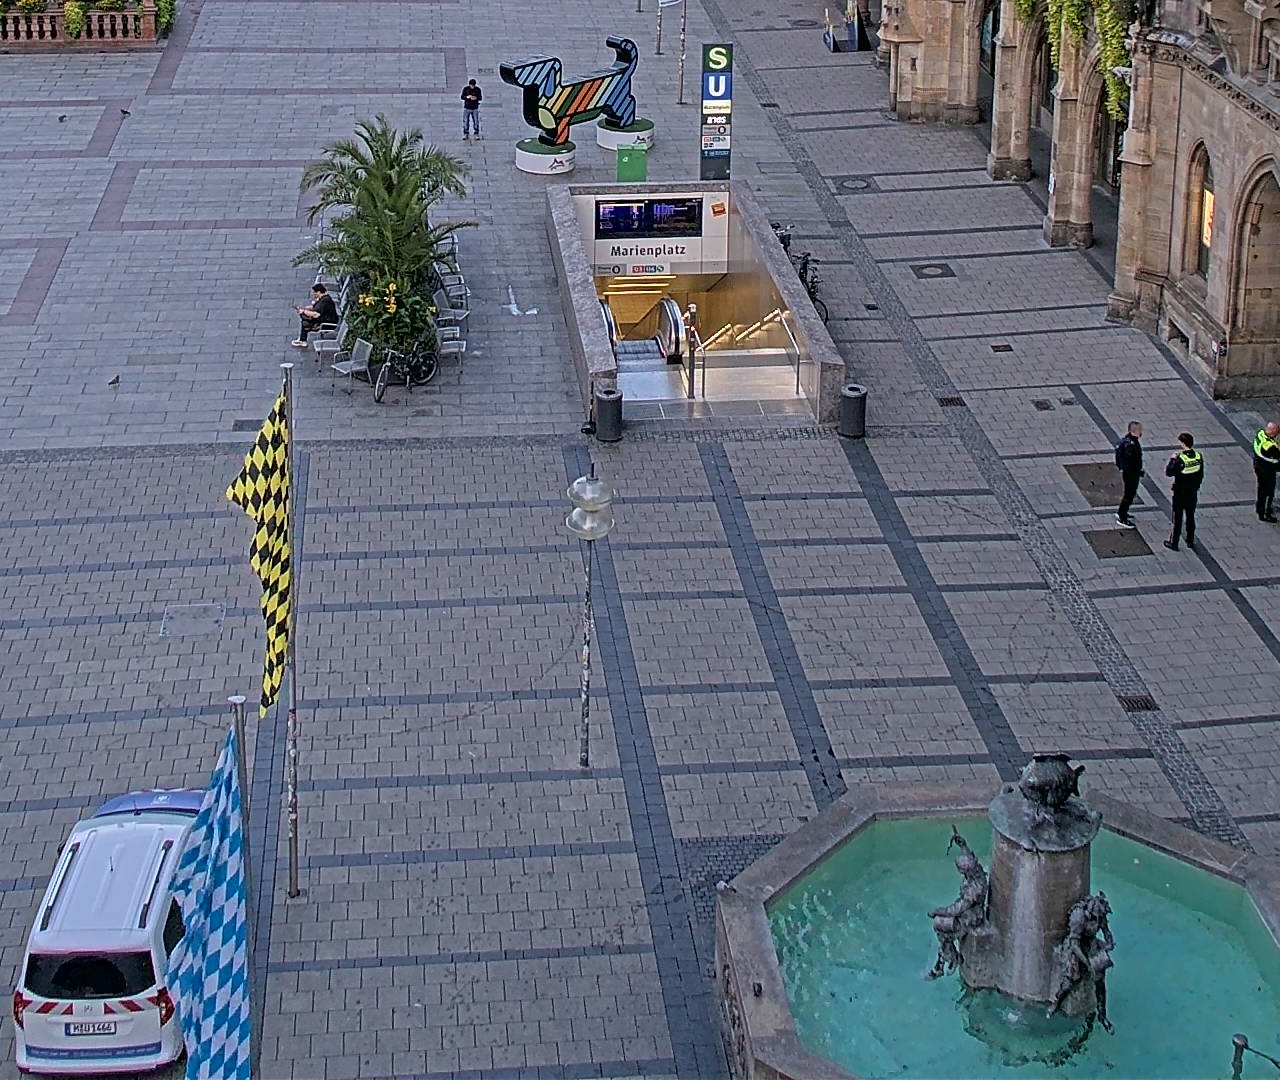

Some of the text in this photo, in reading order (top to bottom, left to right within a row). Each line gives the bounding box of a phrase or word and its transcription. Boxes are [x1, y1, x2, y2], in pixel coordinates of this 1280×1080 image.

[709, 47, 728, 70] S
[708, 75, 726, 97] U
[610, 244, 687, 258] Marienplatz
